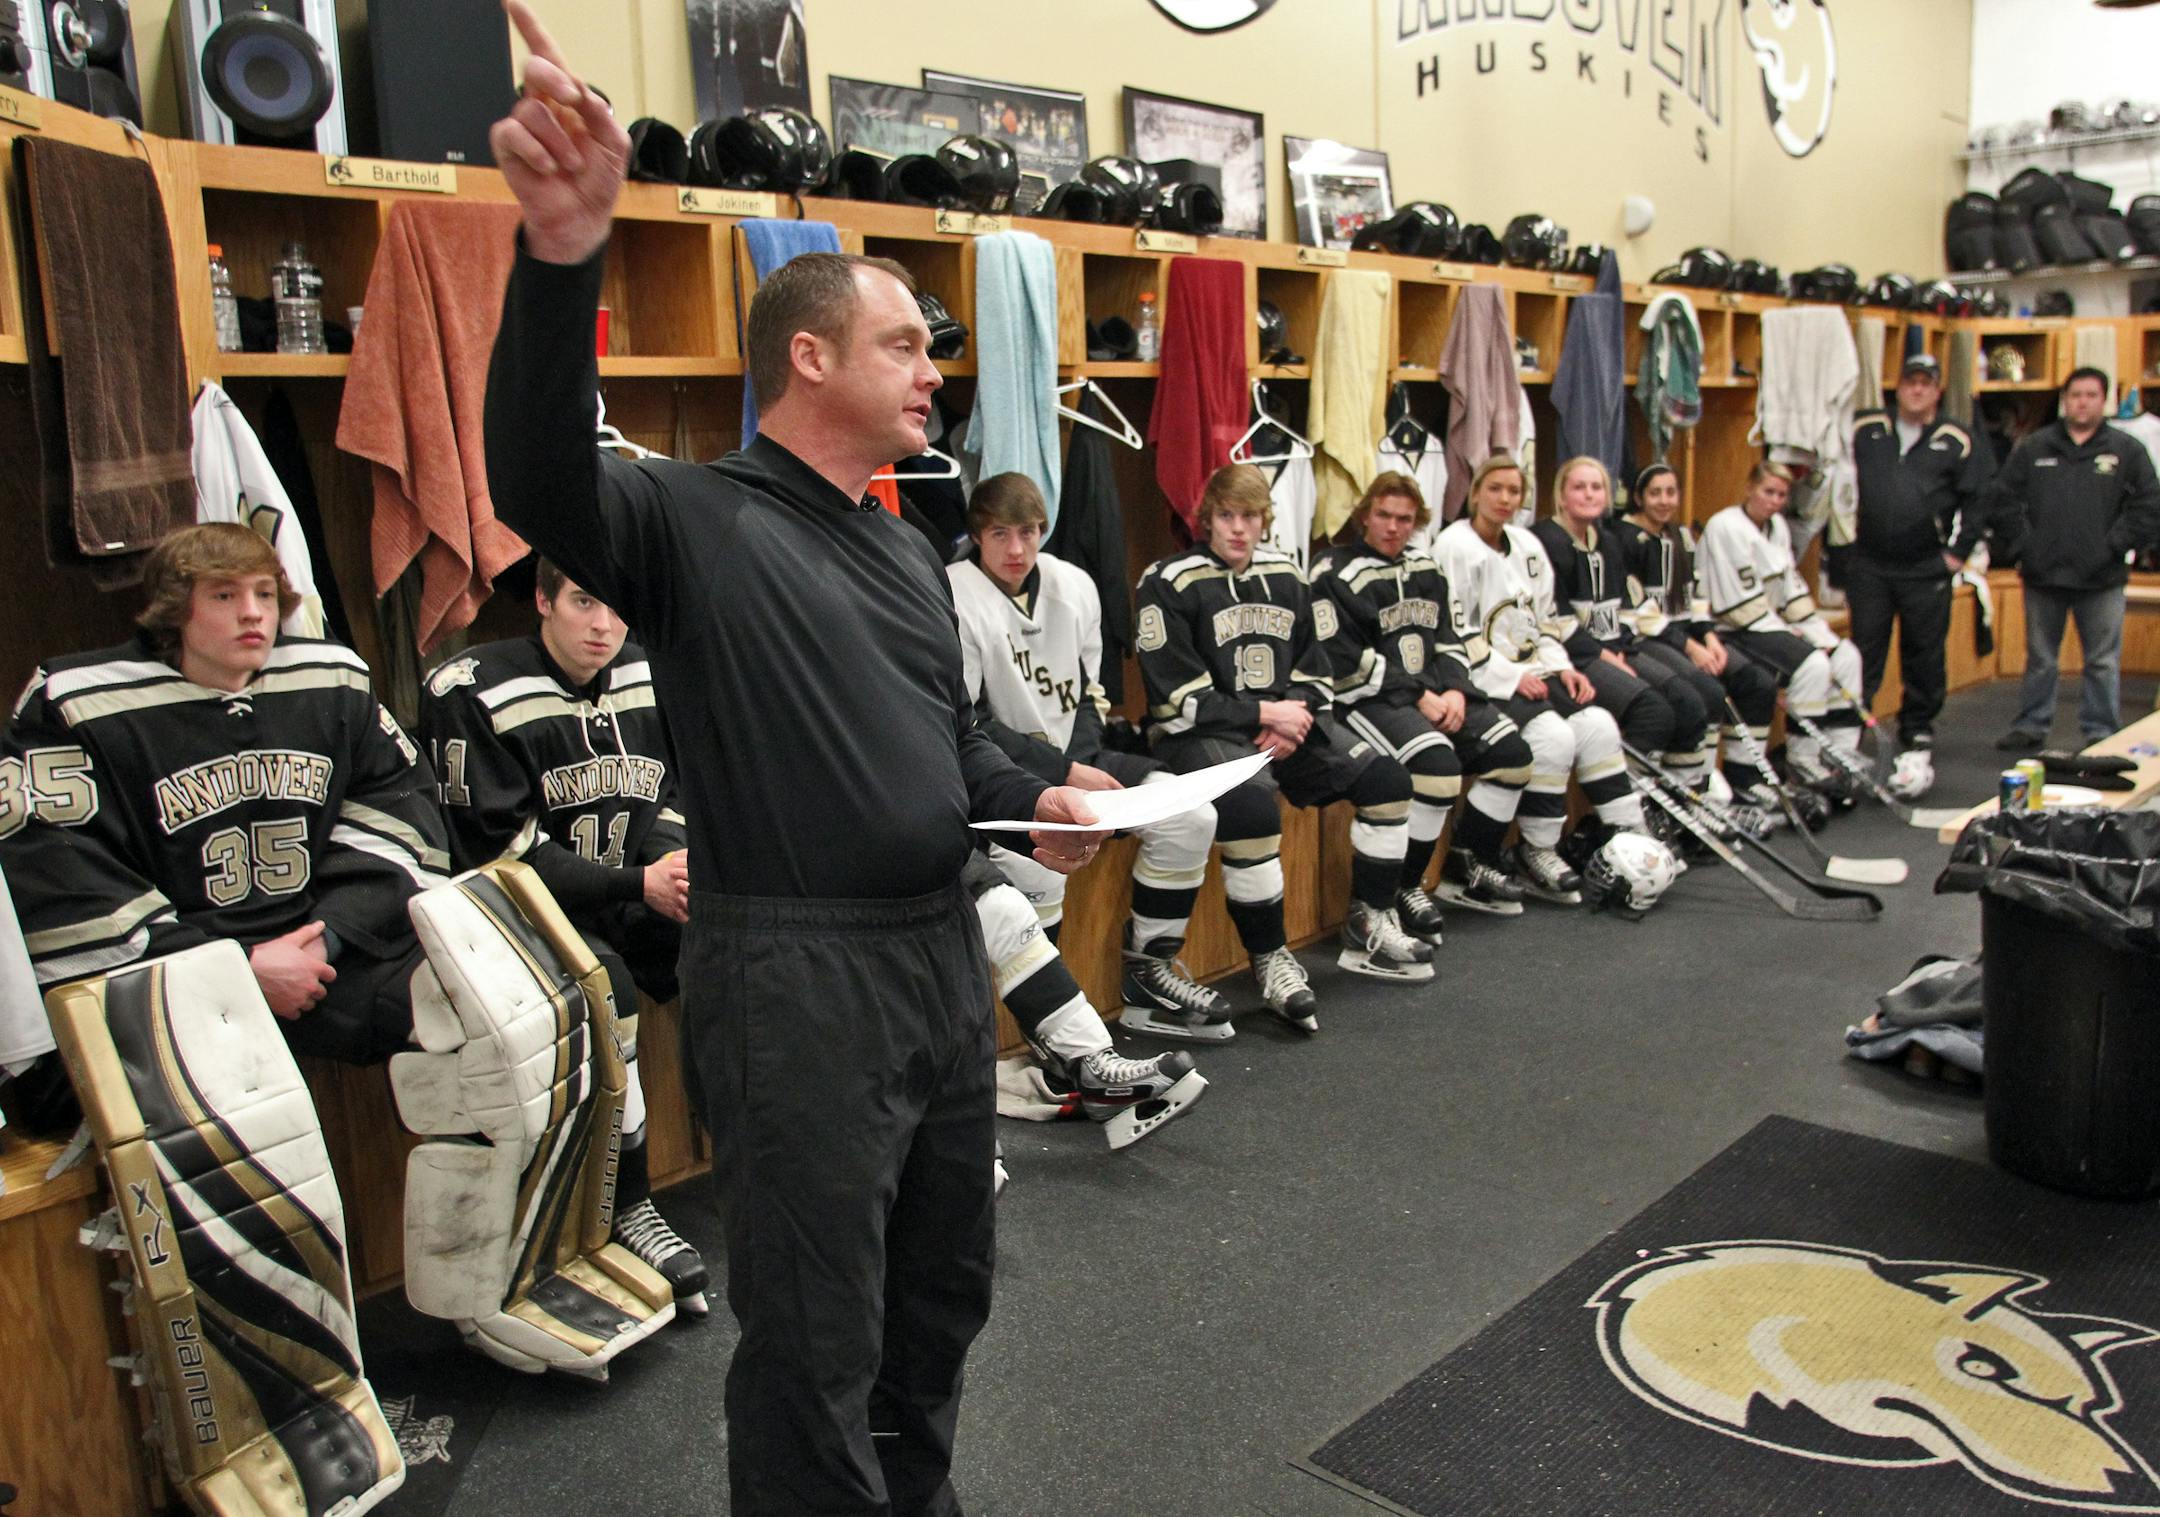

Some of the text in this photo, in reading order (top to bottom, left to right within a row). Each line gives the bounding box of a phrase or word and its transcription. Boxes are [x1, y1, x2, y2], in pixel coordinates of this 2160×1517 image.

[1396, 0, 1725, 127] AOVER
[1416, 40, 1709, 164] HUSKIES
[372, 165, 440, 185] Barthold
[1527, 556, 1539, 578] C
[1738, 566, 1756, 591] 5
[1135, 604, 1168, 652] 9
[1213, 603, 1296, 647] ANOVER
[1007, 632, 1080, 714] USK
[1234, 643, 1275, 692] 19
[1397, 633, 1425, 675] 8
[153, 749, 334, 836] ANDOVER
[430, 738, 471, 807] 1
[201, 816, 311, 907] 35
[570, 811, 630, 869] 11
